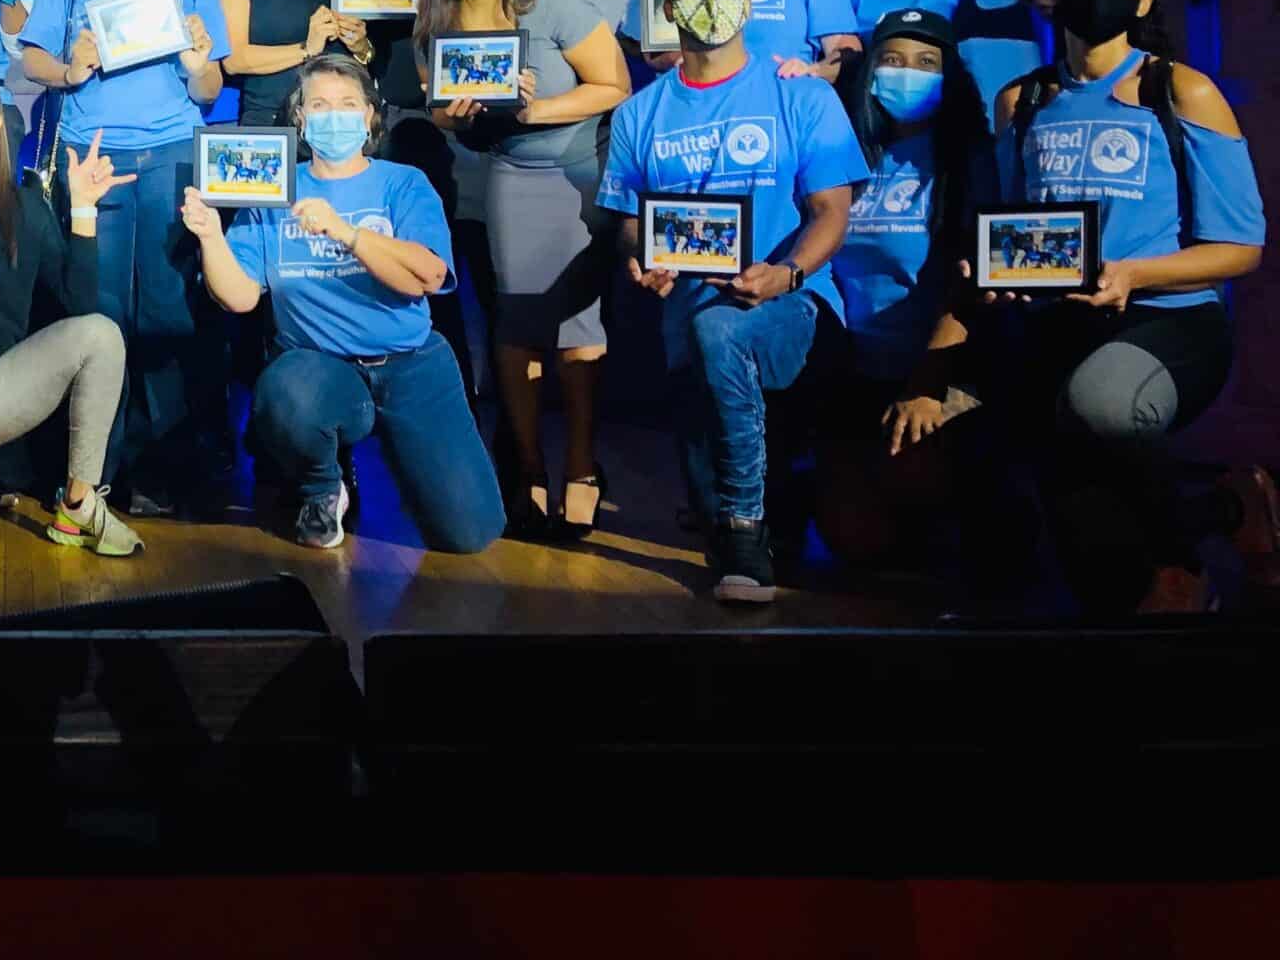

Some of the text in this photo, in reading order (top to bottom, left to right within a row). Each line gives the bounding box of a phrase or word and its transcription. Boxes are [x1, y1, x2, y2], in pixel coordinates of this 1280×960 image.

[655, 128, 721, 160] United
[681, 153, 714, 176] Wa
[1039, 151, 1080, 175] Way
